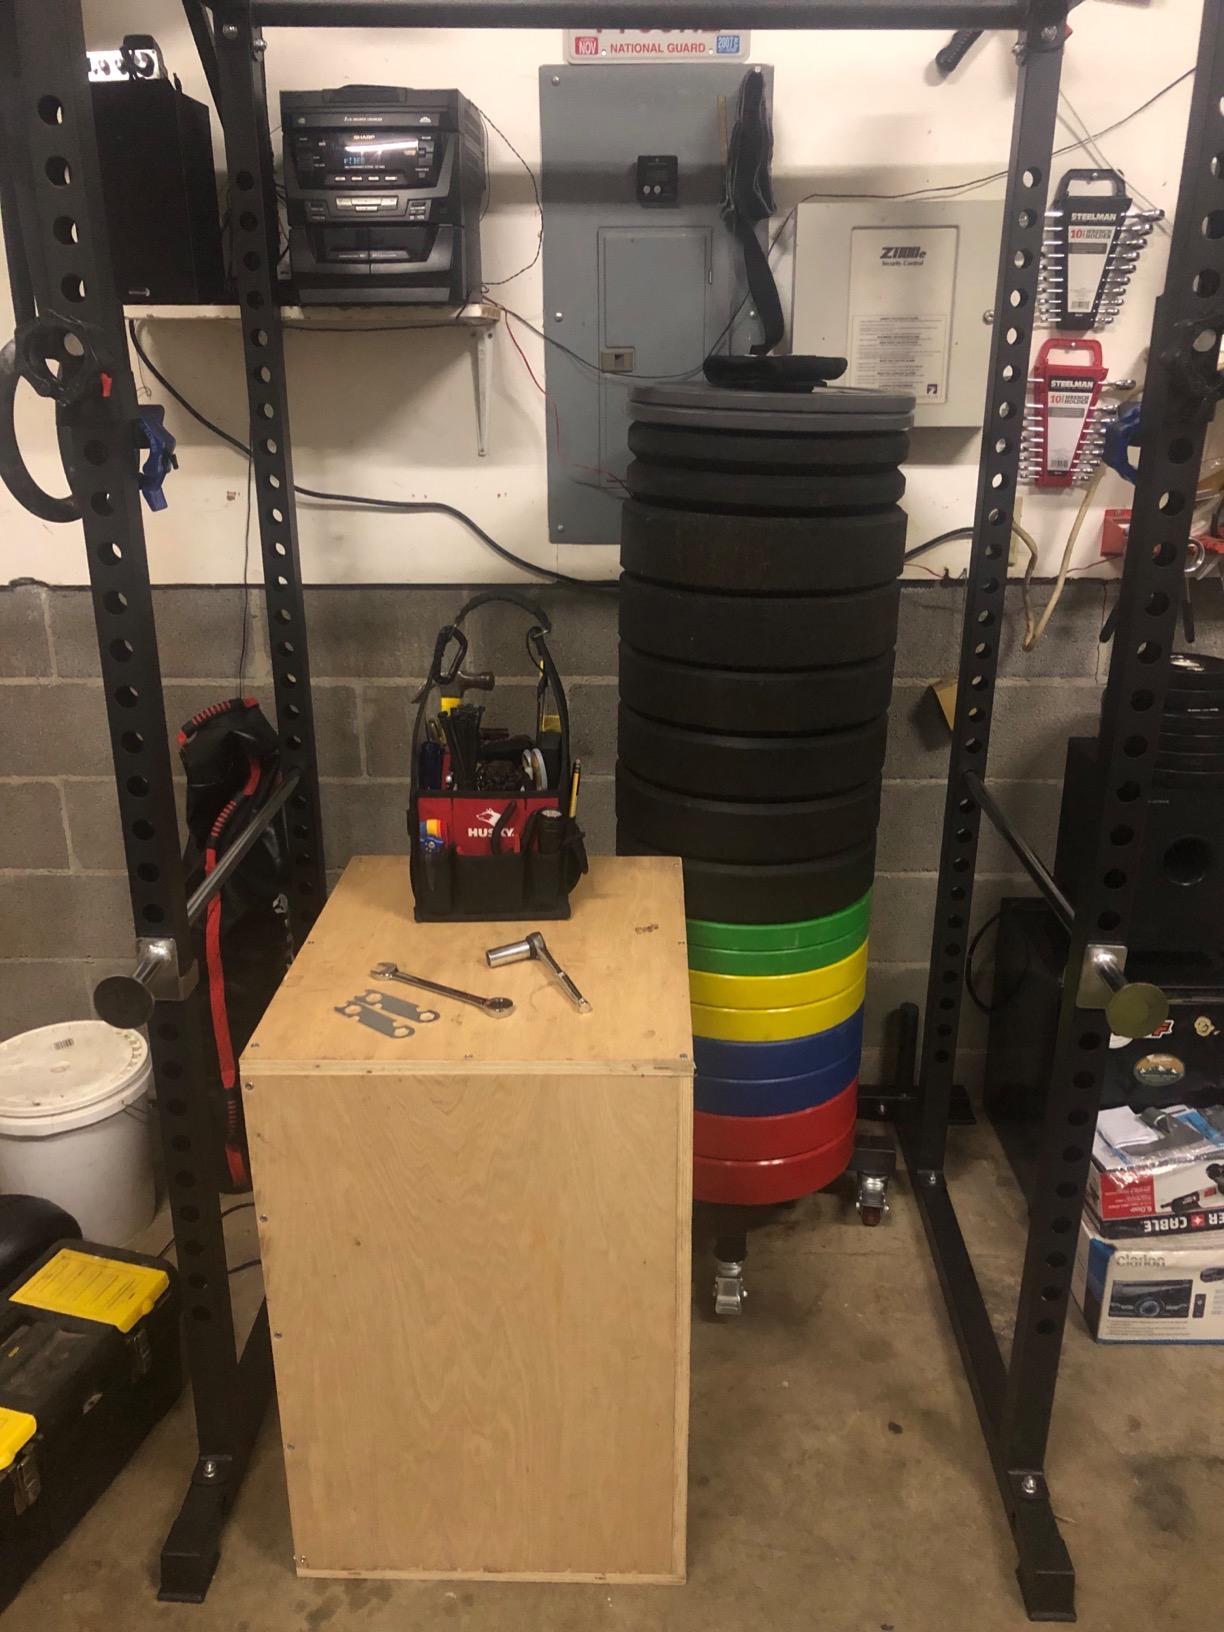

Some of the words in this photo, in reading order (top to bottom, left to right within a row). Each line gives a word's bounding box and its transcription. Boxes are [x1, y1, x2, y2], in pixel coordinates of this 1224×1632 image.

[578, 41, 596, 55] NOV
[610, 43, 664, 54] NATIONAL
[667, 42, 706, 53] GUARD
[1071, 212, 1117, 221] STEELMAN
[1070, 229, 1082, 239] 10
[1050, 379, 1094, 388] STEELMAN
[1050, 395, 1062, 404] 10
[1143, 1216, 1188, 1232] CABLE
[1116, 1254, 1166, 1268] clarion
